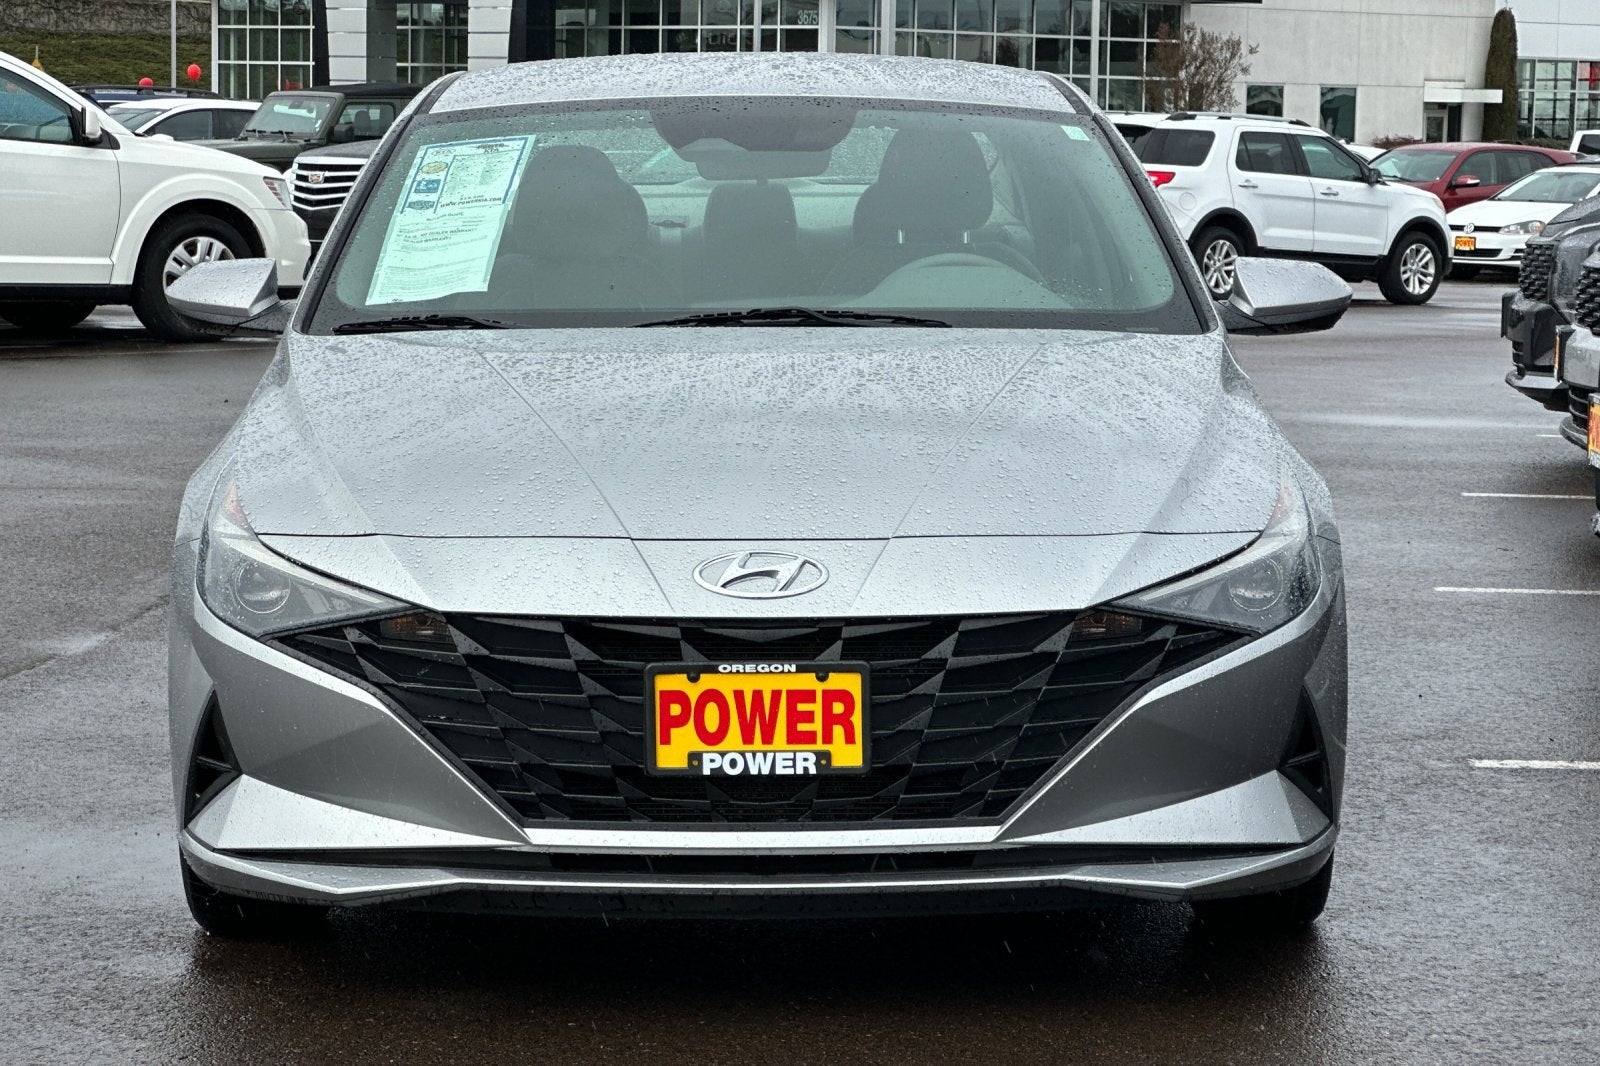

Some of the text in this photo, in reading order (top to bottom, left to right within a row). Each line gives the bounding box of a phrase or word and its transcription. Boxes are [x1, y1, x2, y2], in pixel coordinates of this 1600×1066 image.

[797, 10, 818, 25] 3675
[718, 663, 797, 673] OREGON
[659, 688, 856, 746] POWER
[702, 752, 817, 776] POWER
